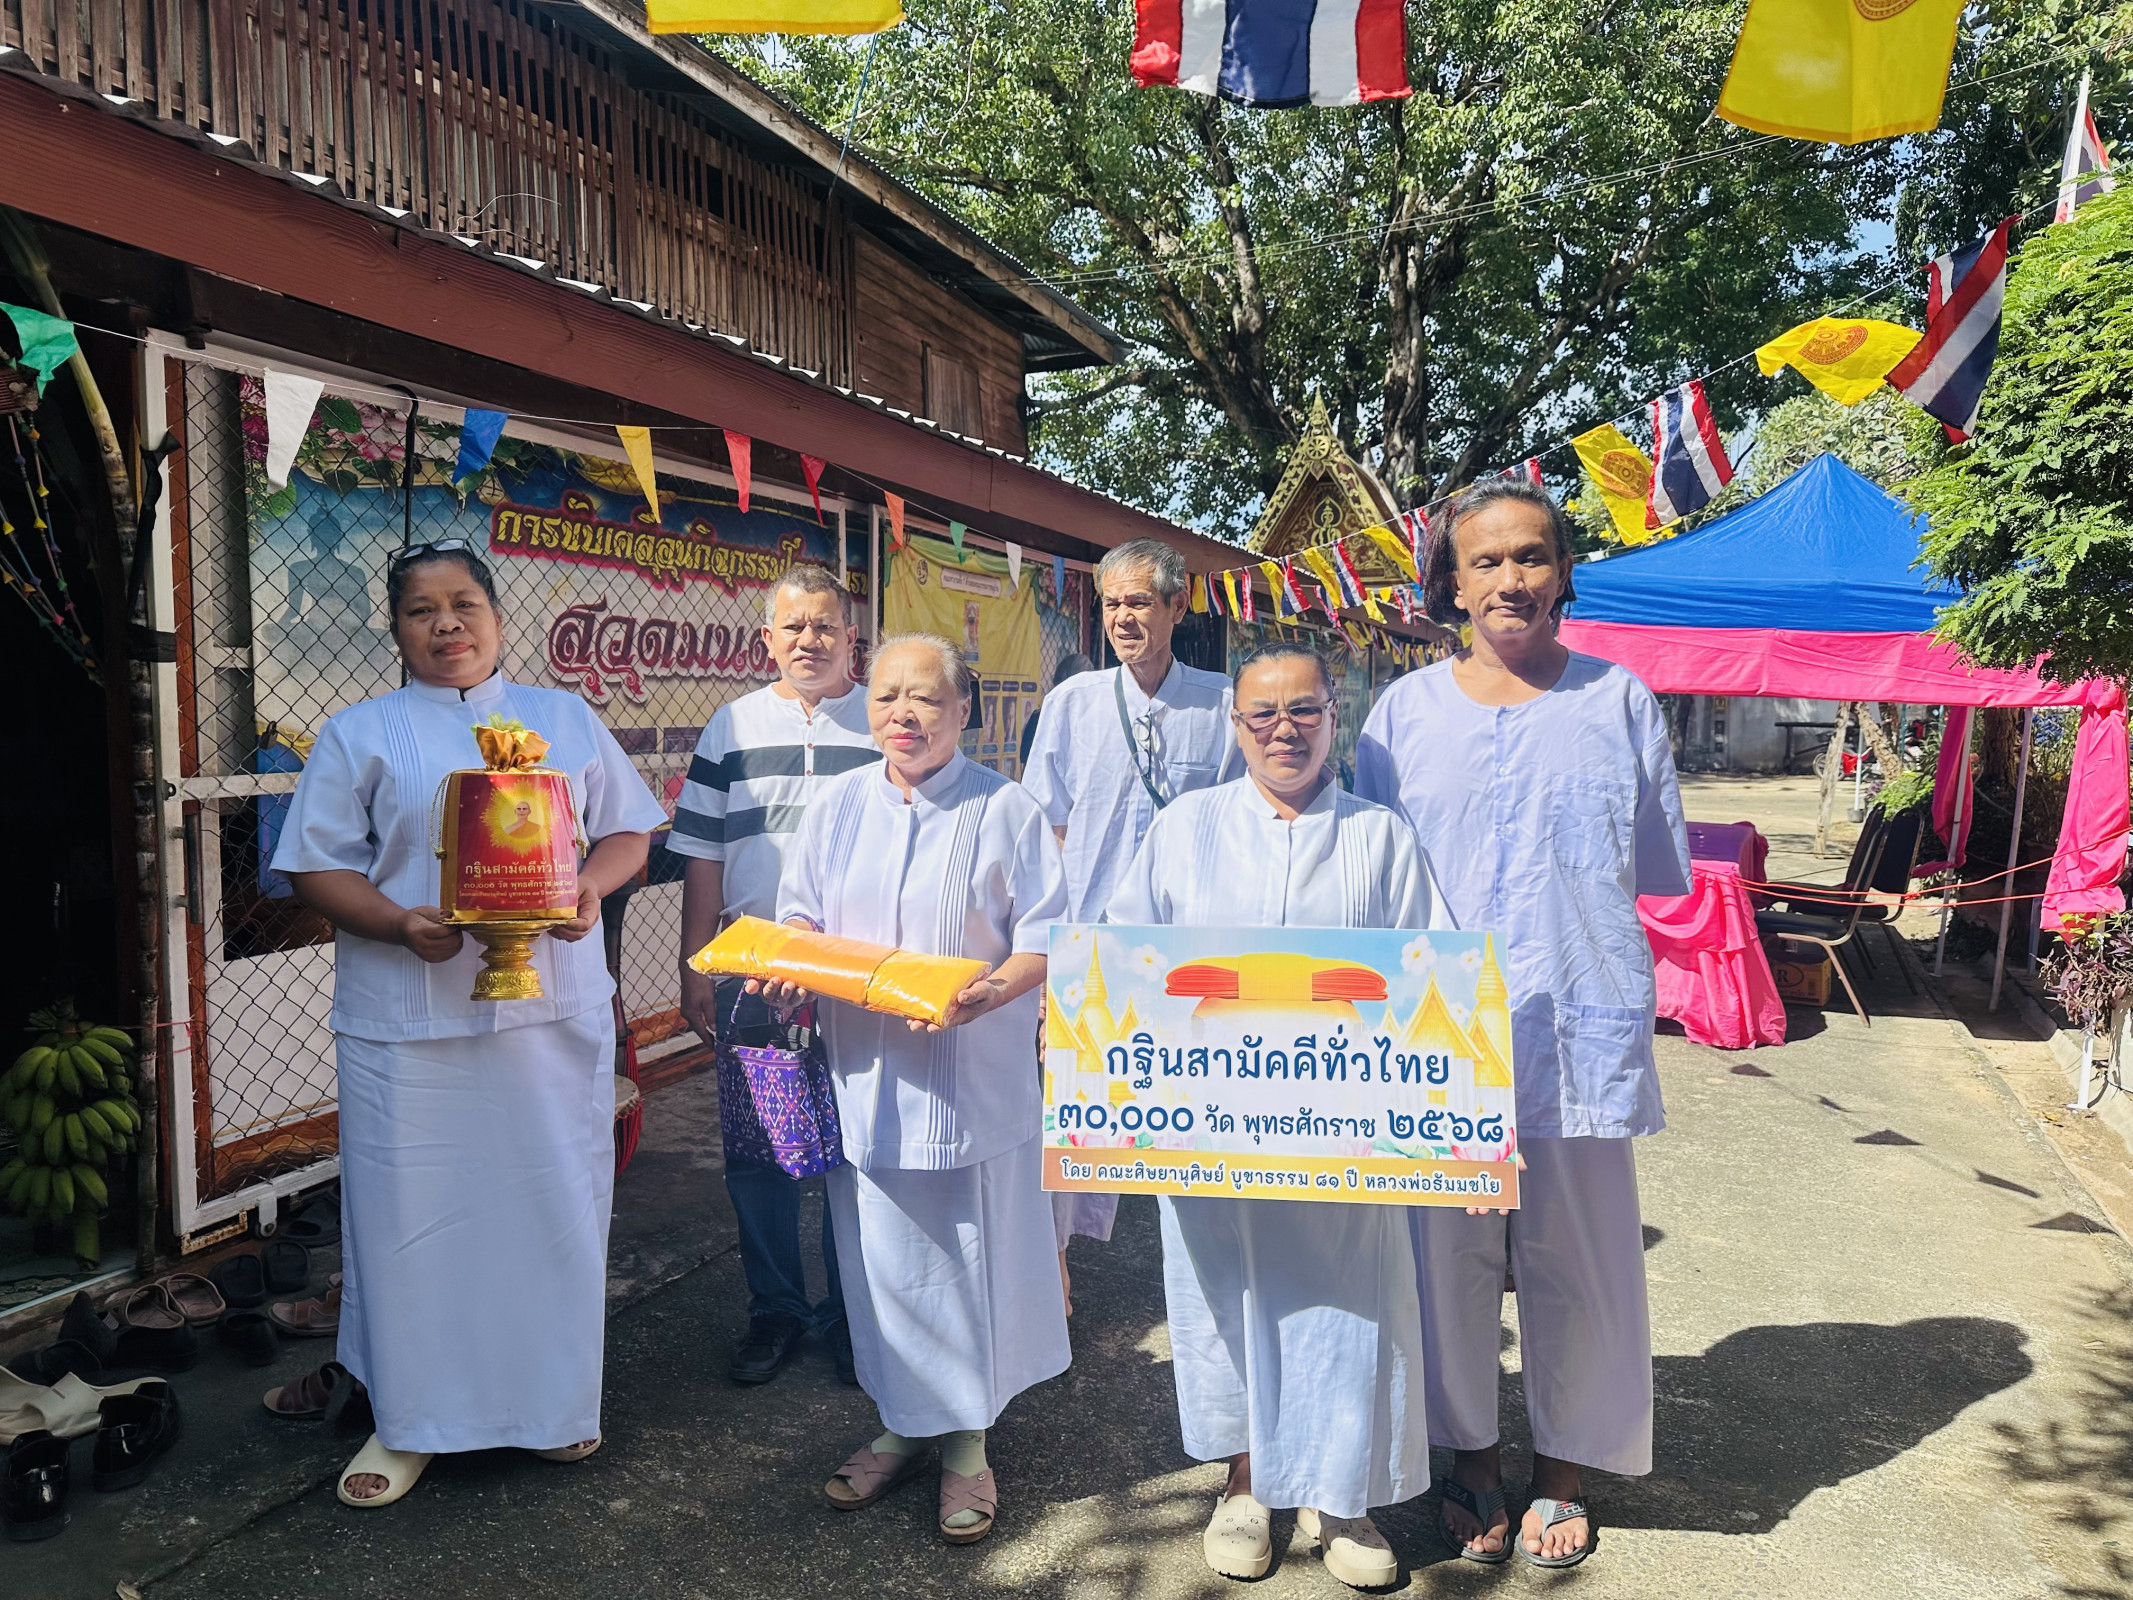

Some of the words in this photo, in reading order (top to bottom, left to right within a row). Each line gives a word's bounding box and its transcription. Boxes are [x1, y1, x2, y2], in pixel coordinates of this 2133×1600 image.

[1106, 1023, 1449, 1090] กฐินสามัคคีทั่วไทย
[1058, 1103, 1194, 1136] ๓๐,๐๐๐
[1205, 1104, 1235, 1133] วัด
[1243, 1107, 1376, 1146] พุทธศักราช
[1387, 1109, 1504, 1143] ๒๕๖๘
[1062, 1158, 1091, 1178] โดย
[1099, 1162, 1224, 1187] คณะศิษยานุศิษย์
[1231, 1169, 1308, 1190] บูชาธรรม
[1316, 1174, 1340, 1188] ๘๑
[1346, 1169, 1358, 1188] ปี
[1365, 1172, 1501, 1194] หลวงพ่อธัมมชโย
